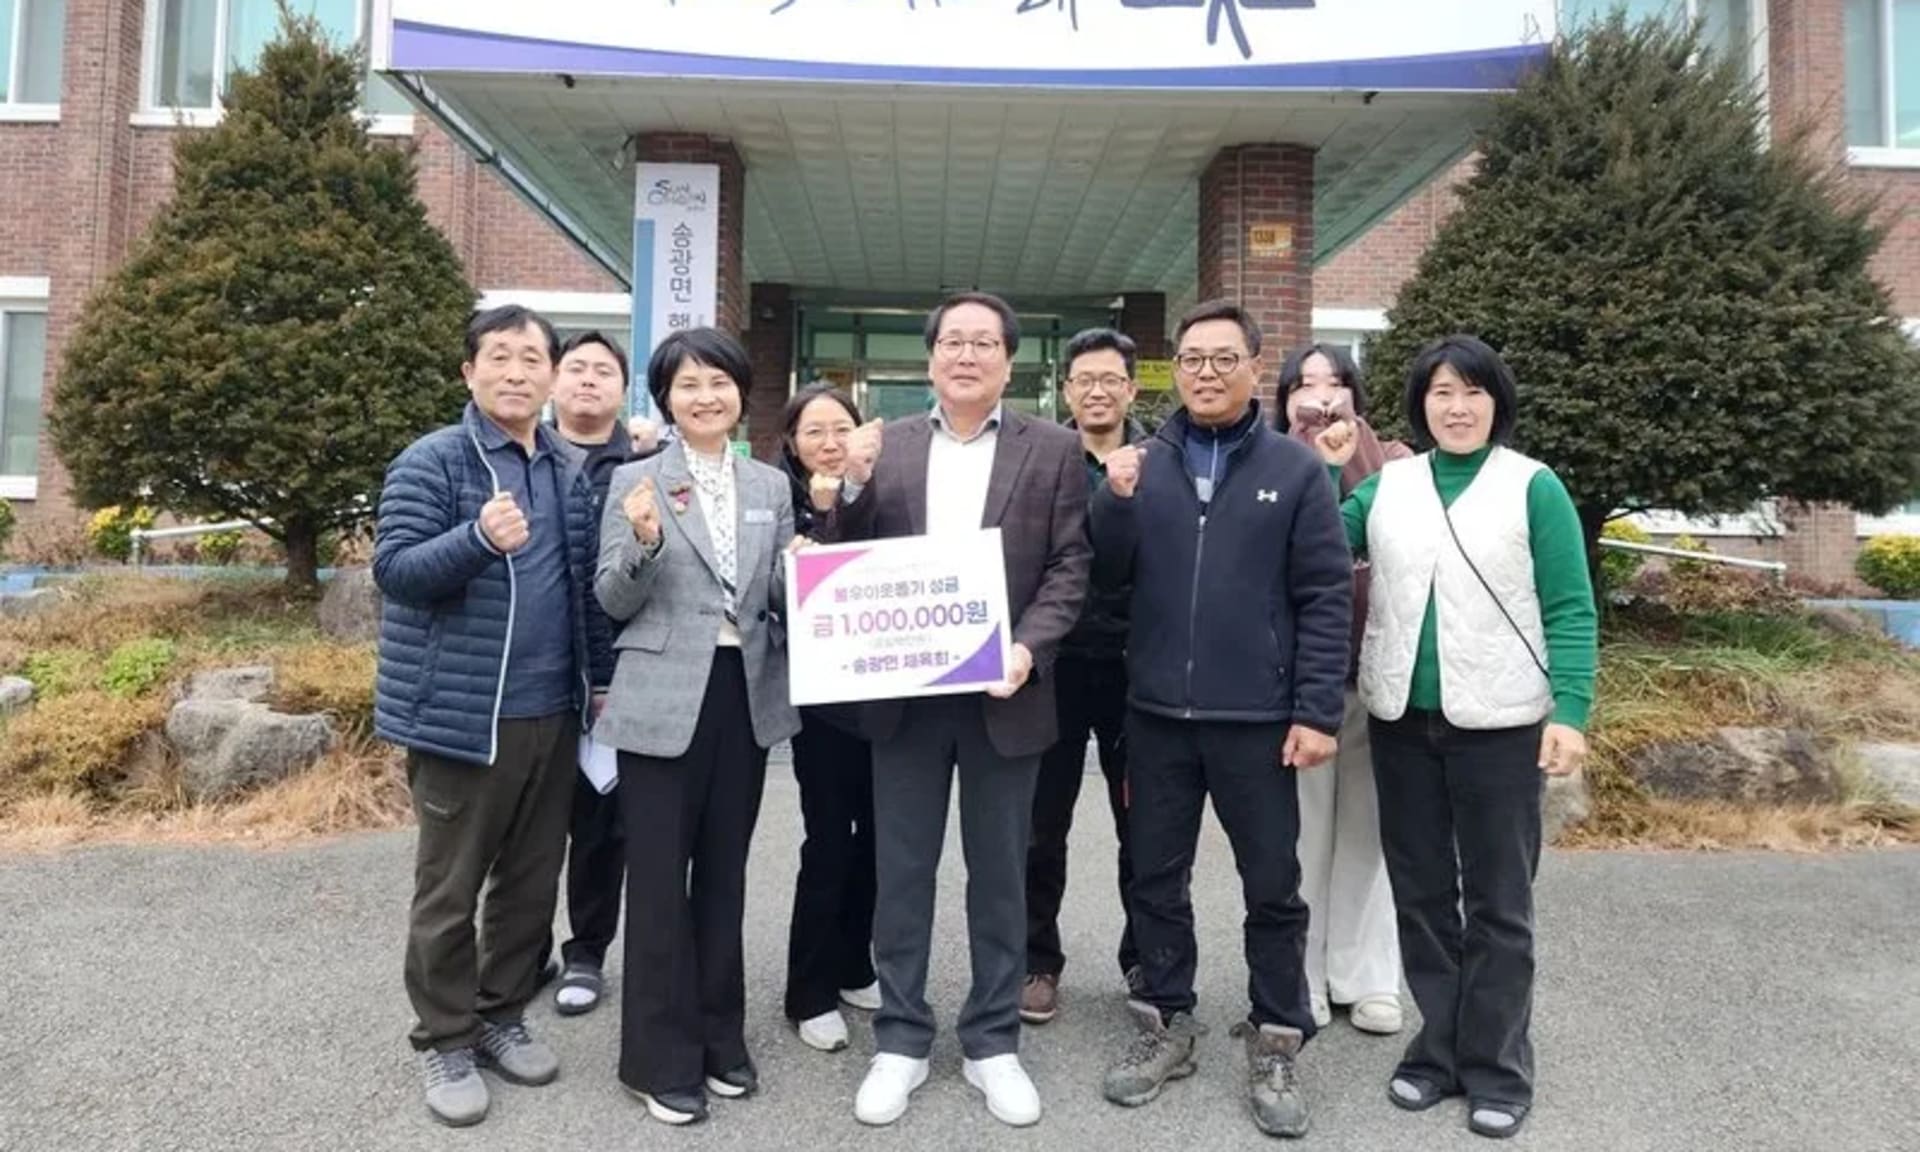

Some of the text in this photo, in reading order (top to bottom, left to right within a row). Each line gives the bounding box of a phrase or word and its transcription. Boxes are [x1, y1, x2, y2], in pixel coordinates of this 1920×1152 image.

[668, 221, 694, 304] 송광면
[813, 600, 988, 638] 금 1,000,000원
